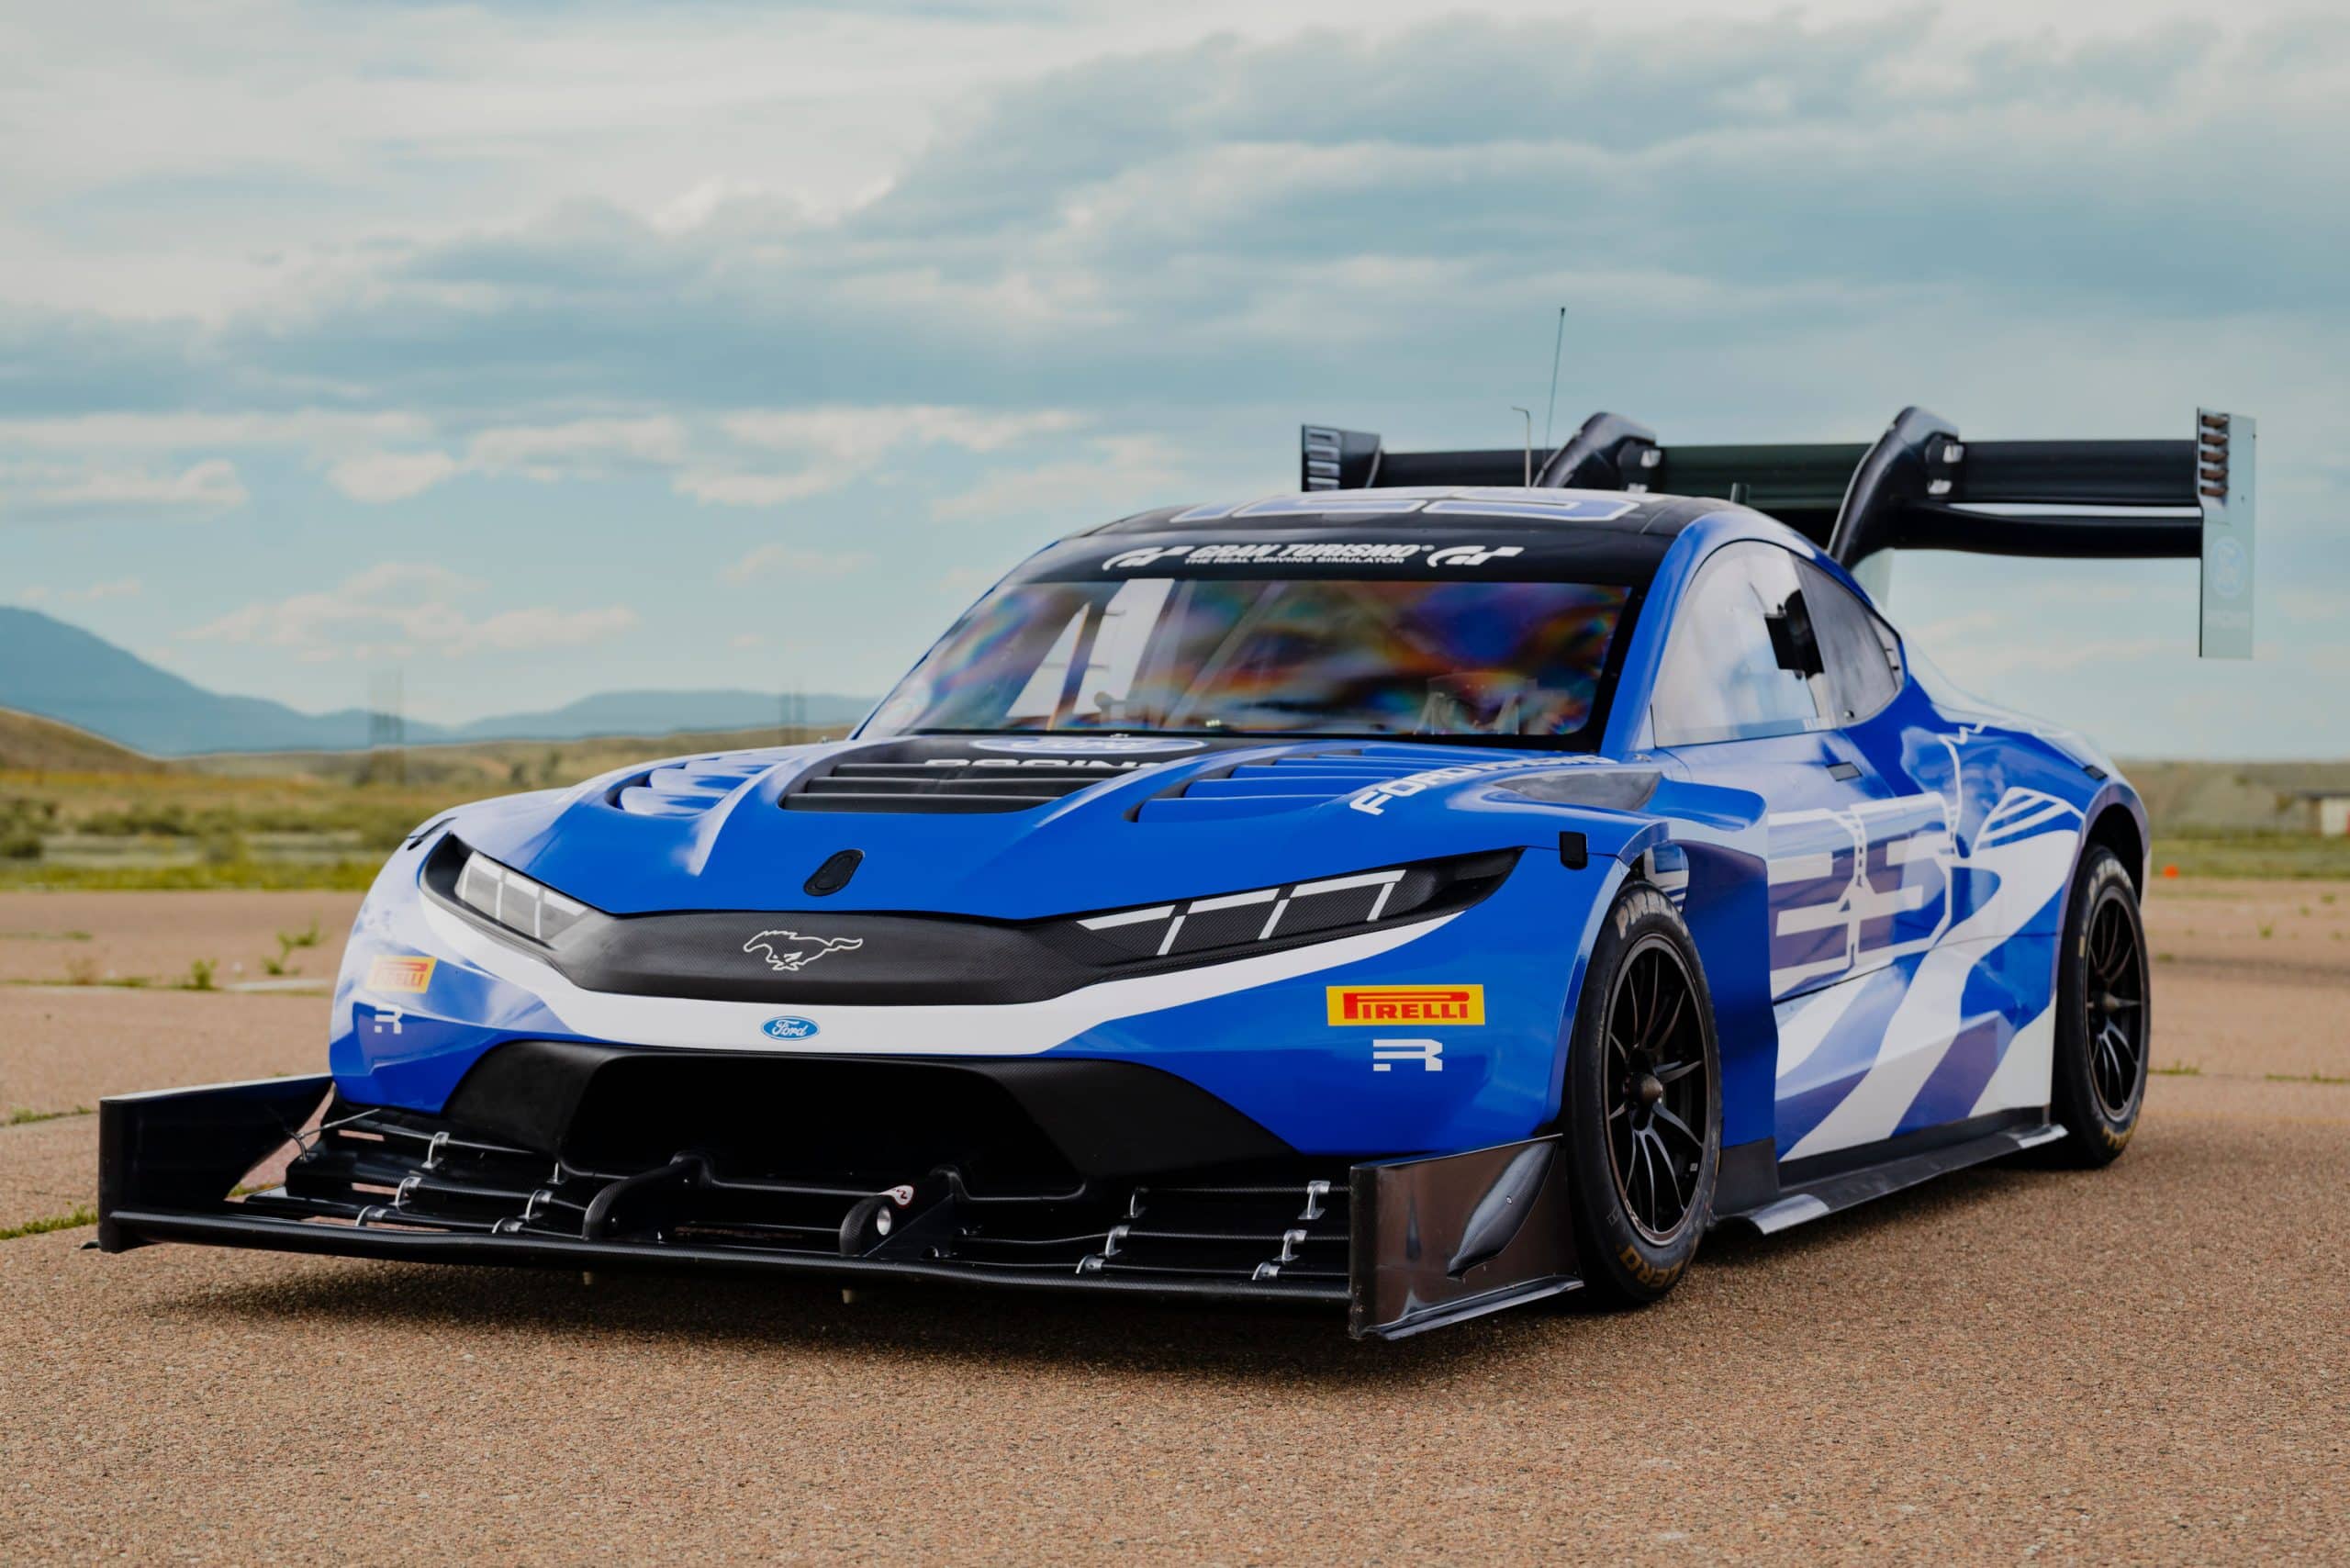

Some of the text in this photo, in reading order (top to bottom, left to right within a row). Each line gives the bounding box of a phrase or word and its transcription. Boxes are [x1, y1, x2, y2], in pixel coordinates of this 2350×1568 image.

[1188, 543, 1281, 558] GRAN
[1277, 543, 1422, 558] TURISMO
[1342, 991, 1471, 1020] PIRELLI
[771, 1019, 809, 1037] Ford
